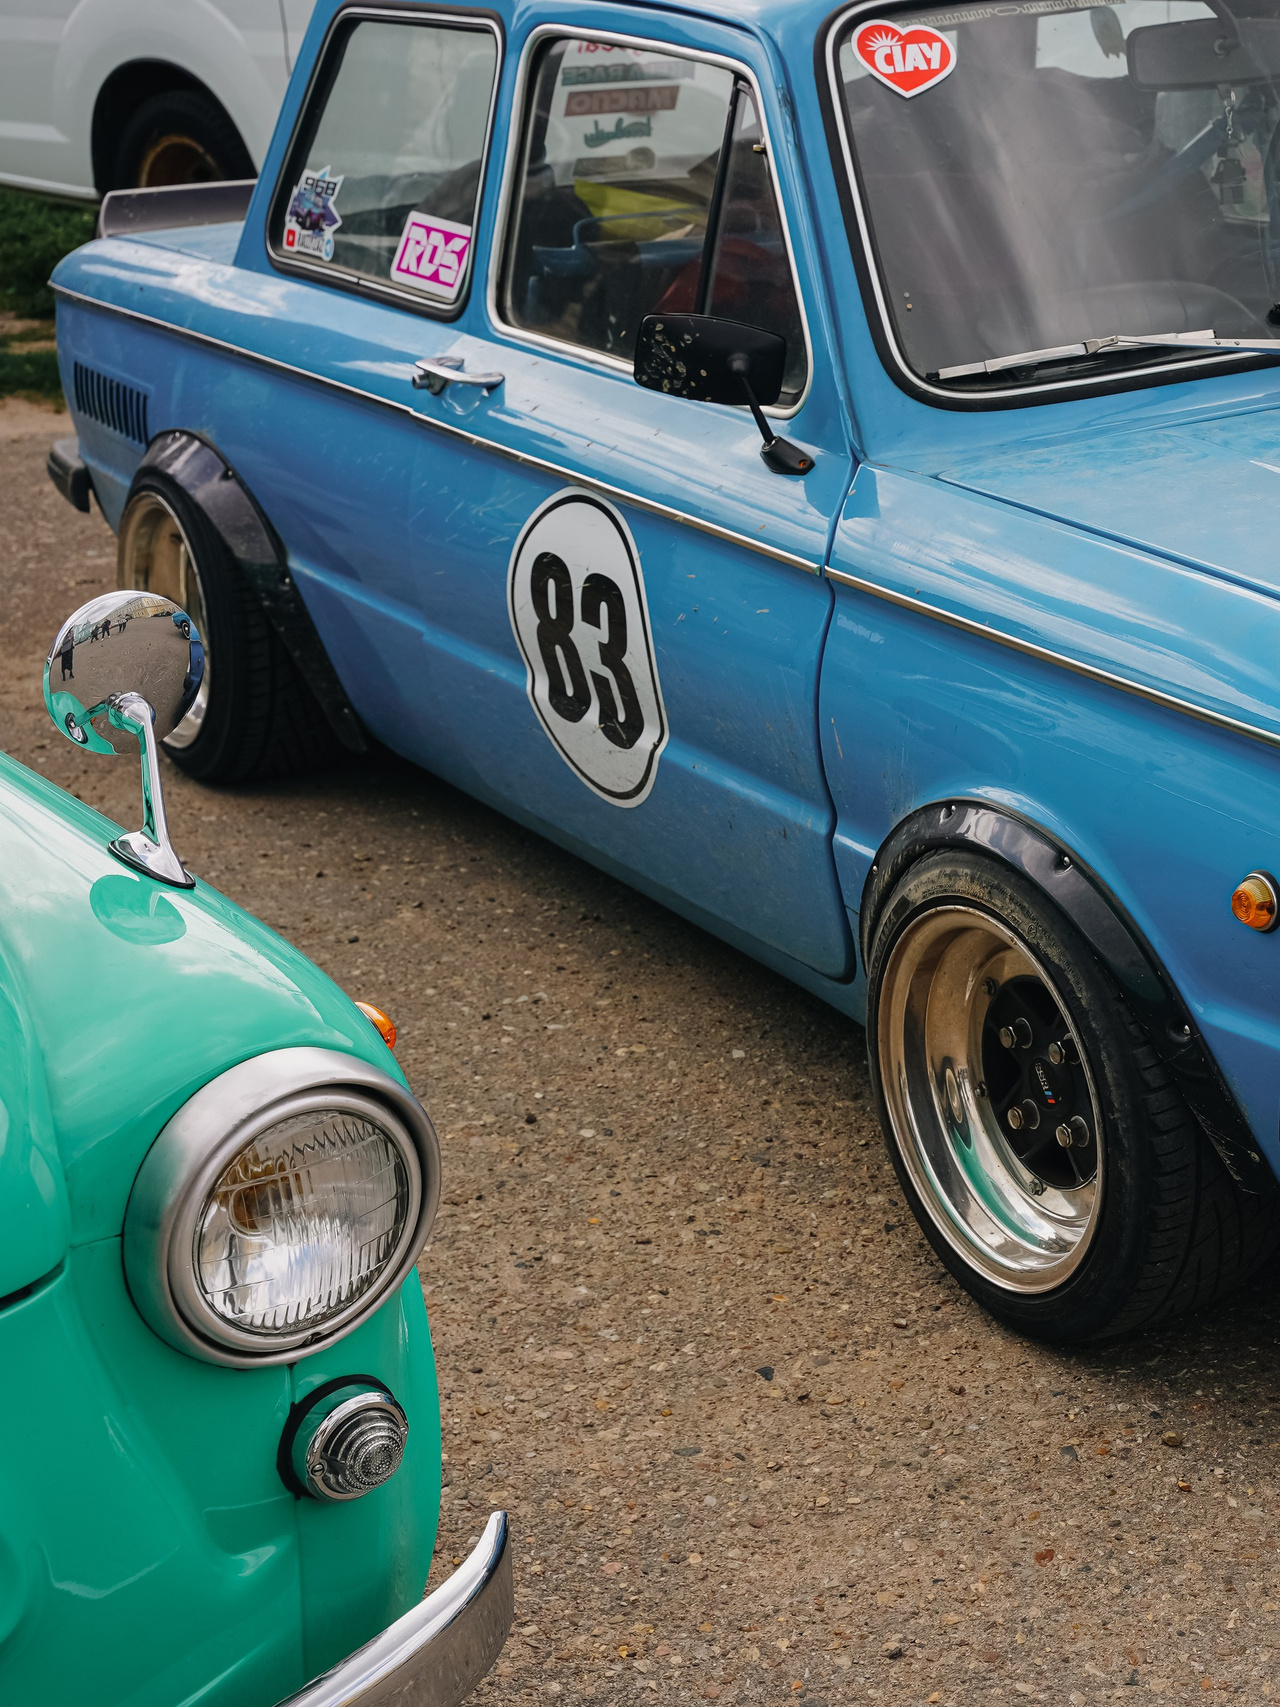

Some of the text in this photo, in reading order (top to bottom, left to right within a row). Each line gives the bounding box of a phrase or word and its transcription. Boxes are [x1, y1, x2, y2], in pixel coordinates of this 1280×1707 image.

[304, 177, 337, 196] 968
[400, 226, 470, 284] RDS
[531, 551, 644, 749] 83
